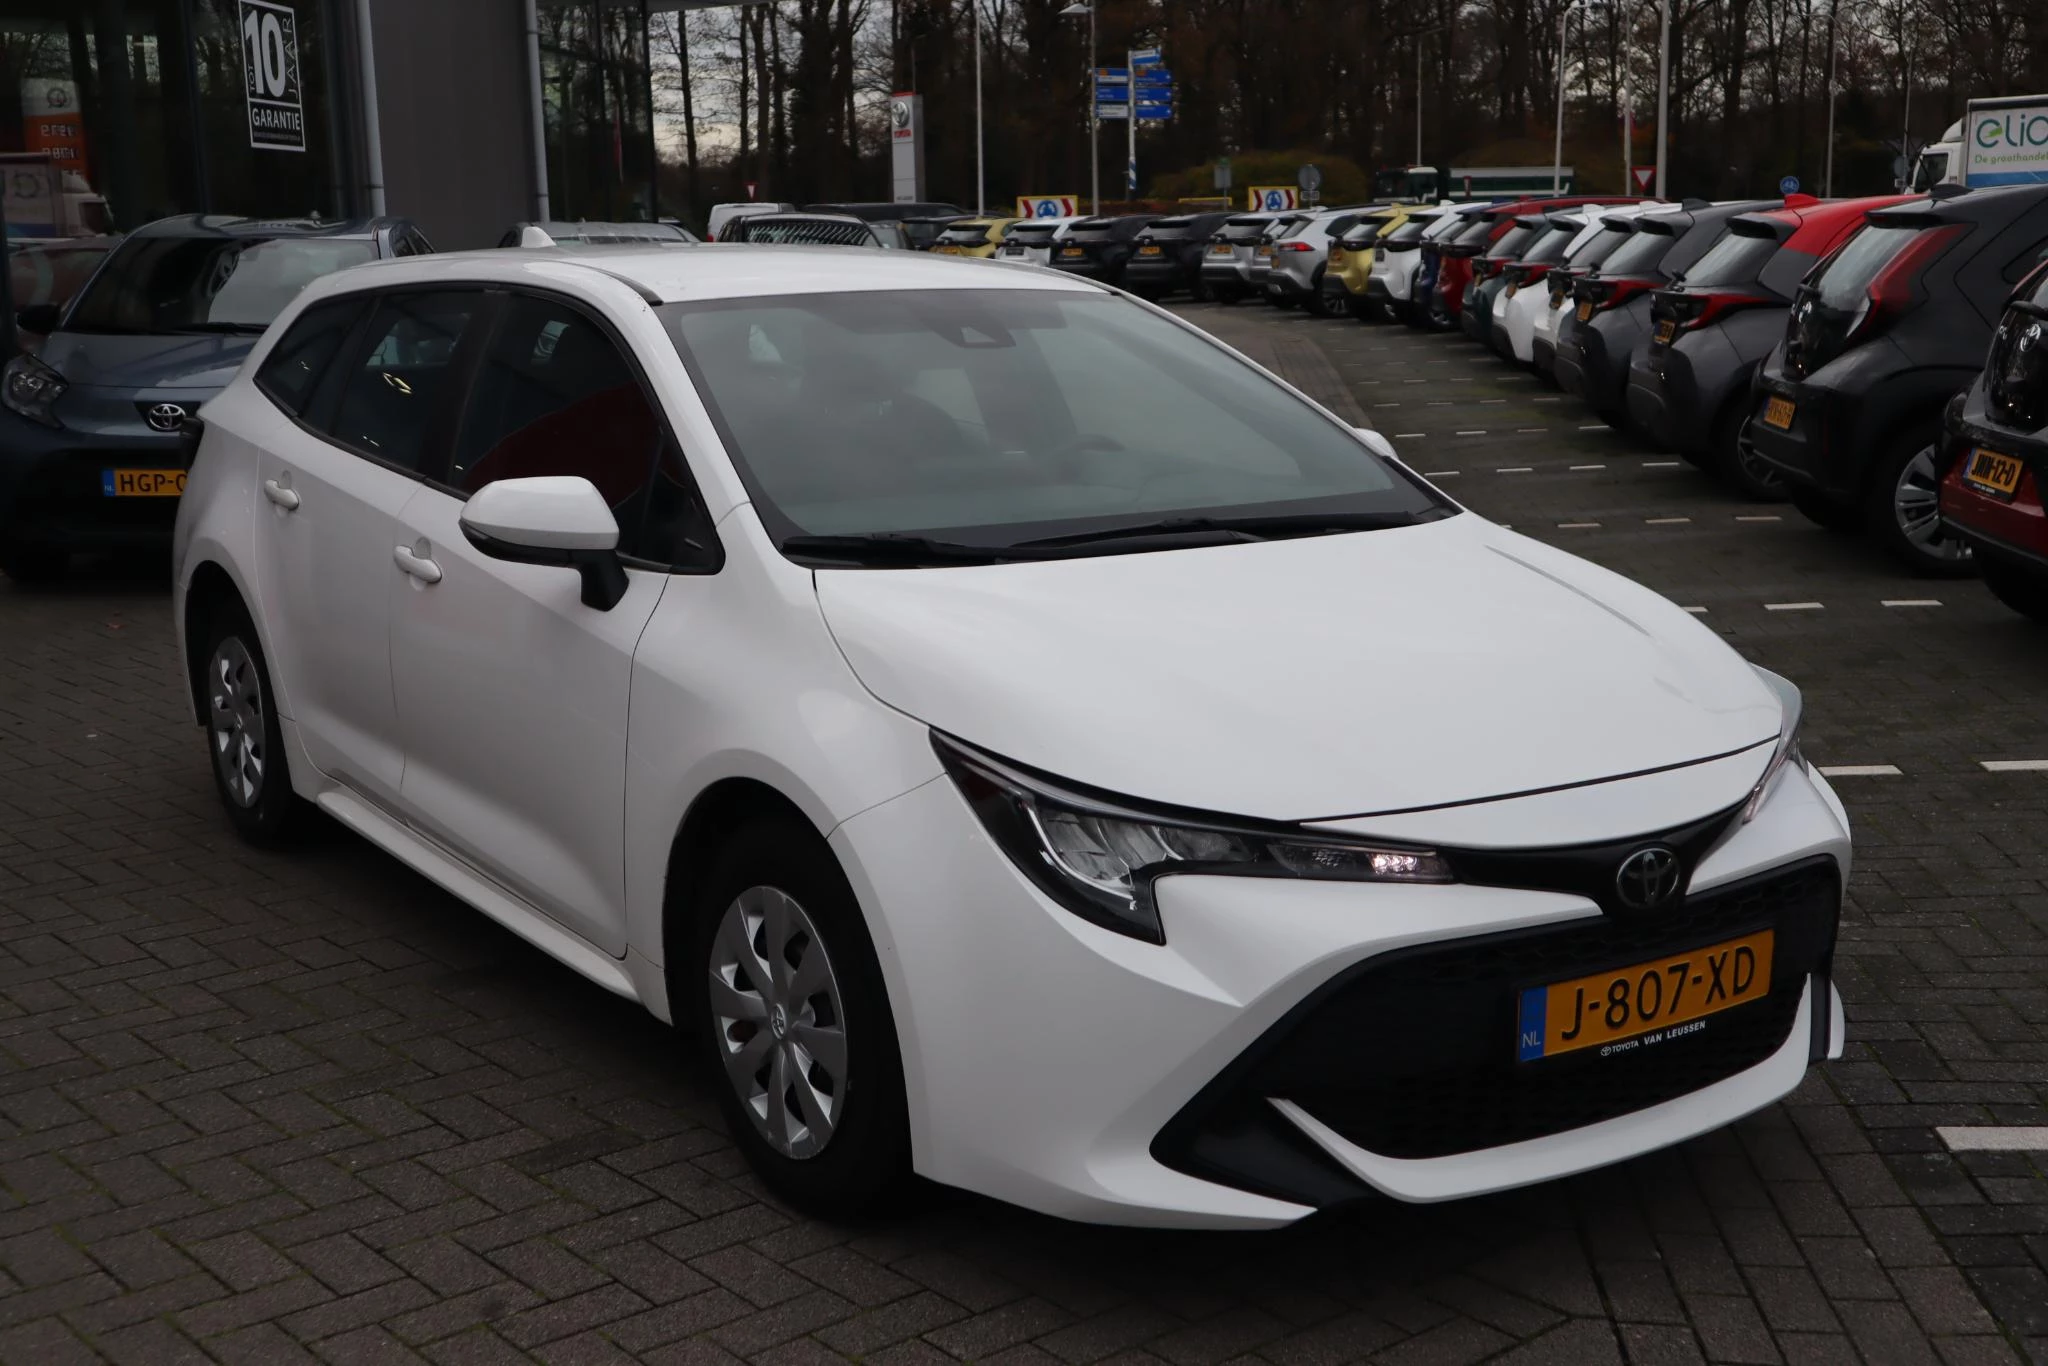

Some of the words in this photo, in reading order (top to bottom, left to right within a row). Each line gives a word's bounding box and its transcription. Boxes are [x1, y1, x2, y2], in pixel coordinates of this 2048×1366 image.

[244, 9, 286, 97] 10
[283, 18, 298, 99] JAAR
[252, 108, 300, 130] GARANTIE
[1562, 946, 1755, 1041] J-807-XD
[1522, 1032, 1541, 1047] NL
[1612, 1040, 1639, 1053] TOYOTA
[1644, 1033, 1662, 1045] VAN
[1667, 1020, 1706, 1039] LEUSSEN
